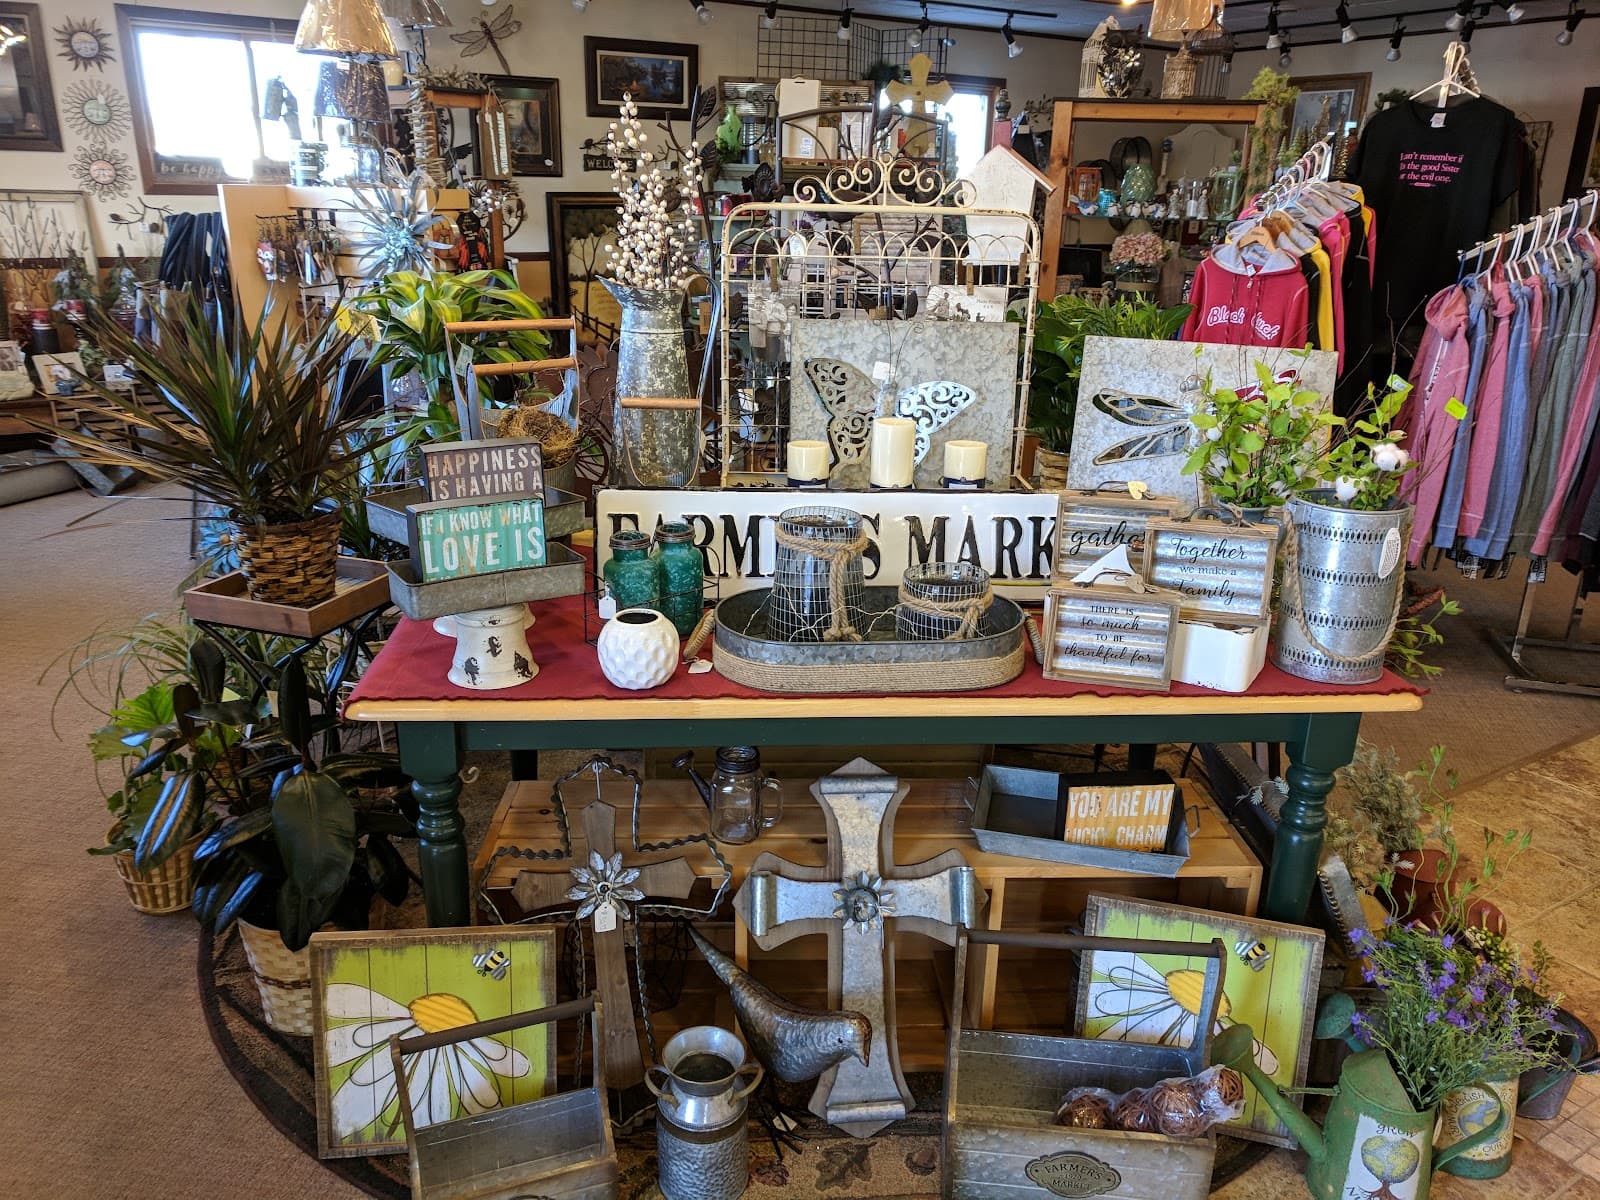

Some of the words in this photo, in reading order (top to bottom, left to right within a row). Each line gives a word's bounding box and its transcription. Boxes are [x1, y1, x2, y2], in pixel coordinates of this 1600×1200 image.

[586, 159, 633, 169] WELCE
[1403, 152, 1418, 160] an't
[1420, 153, 1458, 162] remember
[1407, 161, 1420, 170] the
[1421, 163, 1440, 172] good
[1441, 163, 1460, 173] Sister
[1407, 171, 1420, 180] the
[1421, 173, 1434, 181] evil
[426, 446, 542, 478] HAPPINESS
[430, 479, 450, 500] IS
[455, 471, 525, 498] HAVING
[532, 470, 543, 490] A
[421, 515, 434, 535] IF
[437, 514, 444, 535] I
[449, 509, 493, 532] KNOW
[498, 502, 541, 527] WHAT
[423, 532, 501, 574] LOVE
[514, 526, 544, 562] IS
[1170, 538, 1248, 564] Together
[1179, 565, 1195, 575] we
[1198, 564, 1228, 576] make
[1230, 568, 1237, 576] a
[1173, 579, 1237, 606] Family
[1090, 605, 1120, 615] THERE
[1125, 608, 1135, 616] IS
[1081, 616, 1096, 627] so
[1101, 616, 1140, 631] much
[1096, 633, 1108, 642] TO
[1113, 635, 1124, 643] BE
[1064, 642, 1126, 665] thankful
[1129, 649, 1153, 667] for
[1069, 791, 1102, 819] YOU
[1104, 790, 1142, 818] ARE
[1143, 789, 1174, 816] MY
[1116, 824, 1168, 847] CHARM
[1045, 1163, 1103, 1180] FARMER'S
[1053, 1179, 1090, 1190] MARKET
